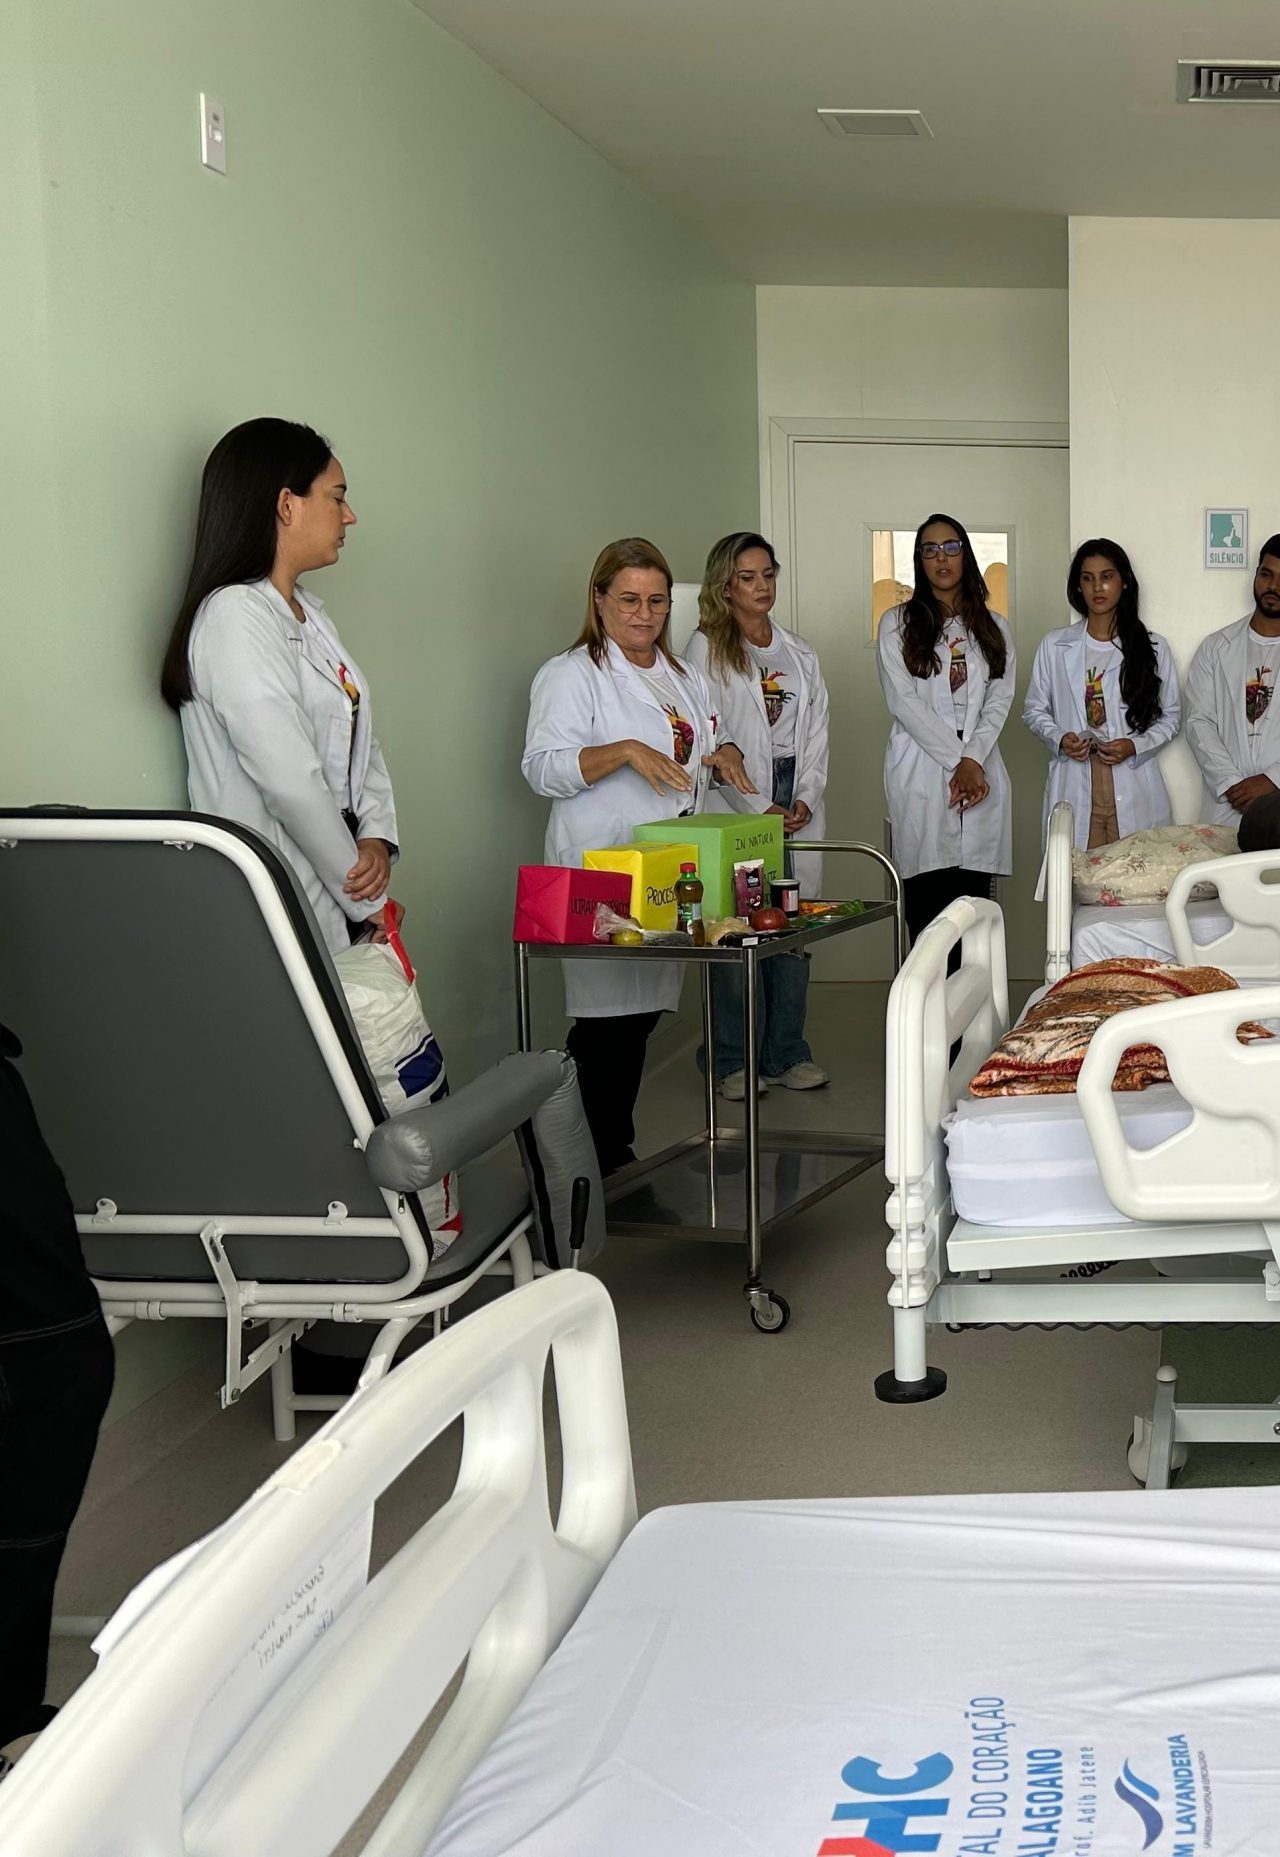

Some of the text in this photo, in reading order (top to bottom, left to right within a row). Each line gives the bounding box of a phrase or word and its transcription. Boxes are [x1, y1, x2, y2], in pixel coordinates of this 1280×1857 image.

[1209, 551, 1244, 564] SILÊNCIO
[735, 832, 774, 851] IN NATURA
[646, 886, 677, 906] PROCES
[956, 1697, 1016, 1857] AL DO CORAÇÃO
[1079, 1746, 1097, 1788] Jatene
[1167, 1734, 1198, 1835] LAVANDERIA
[1076, 1794, 1097, 1823] Adib
